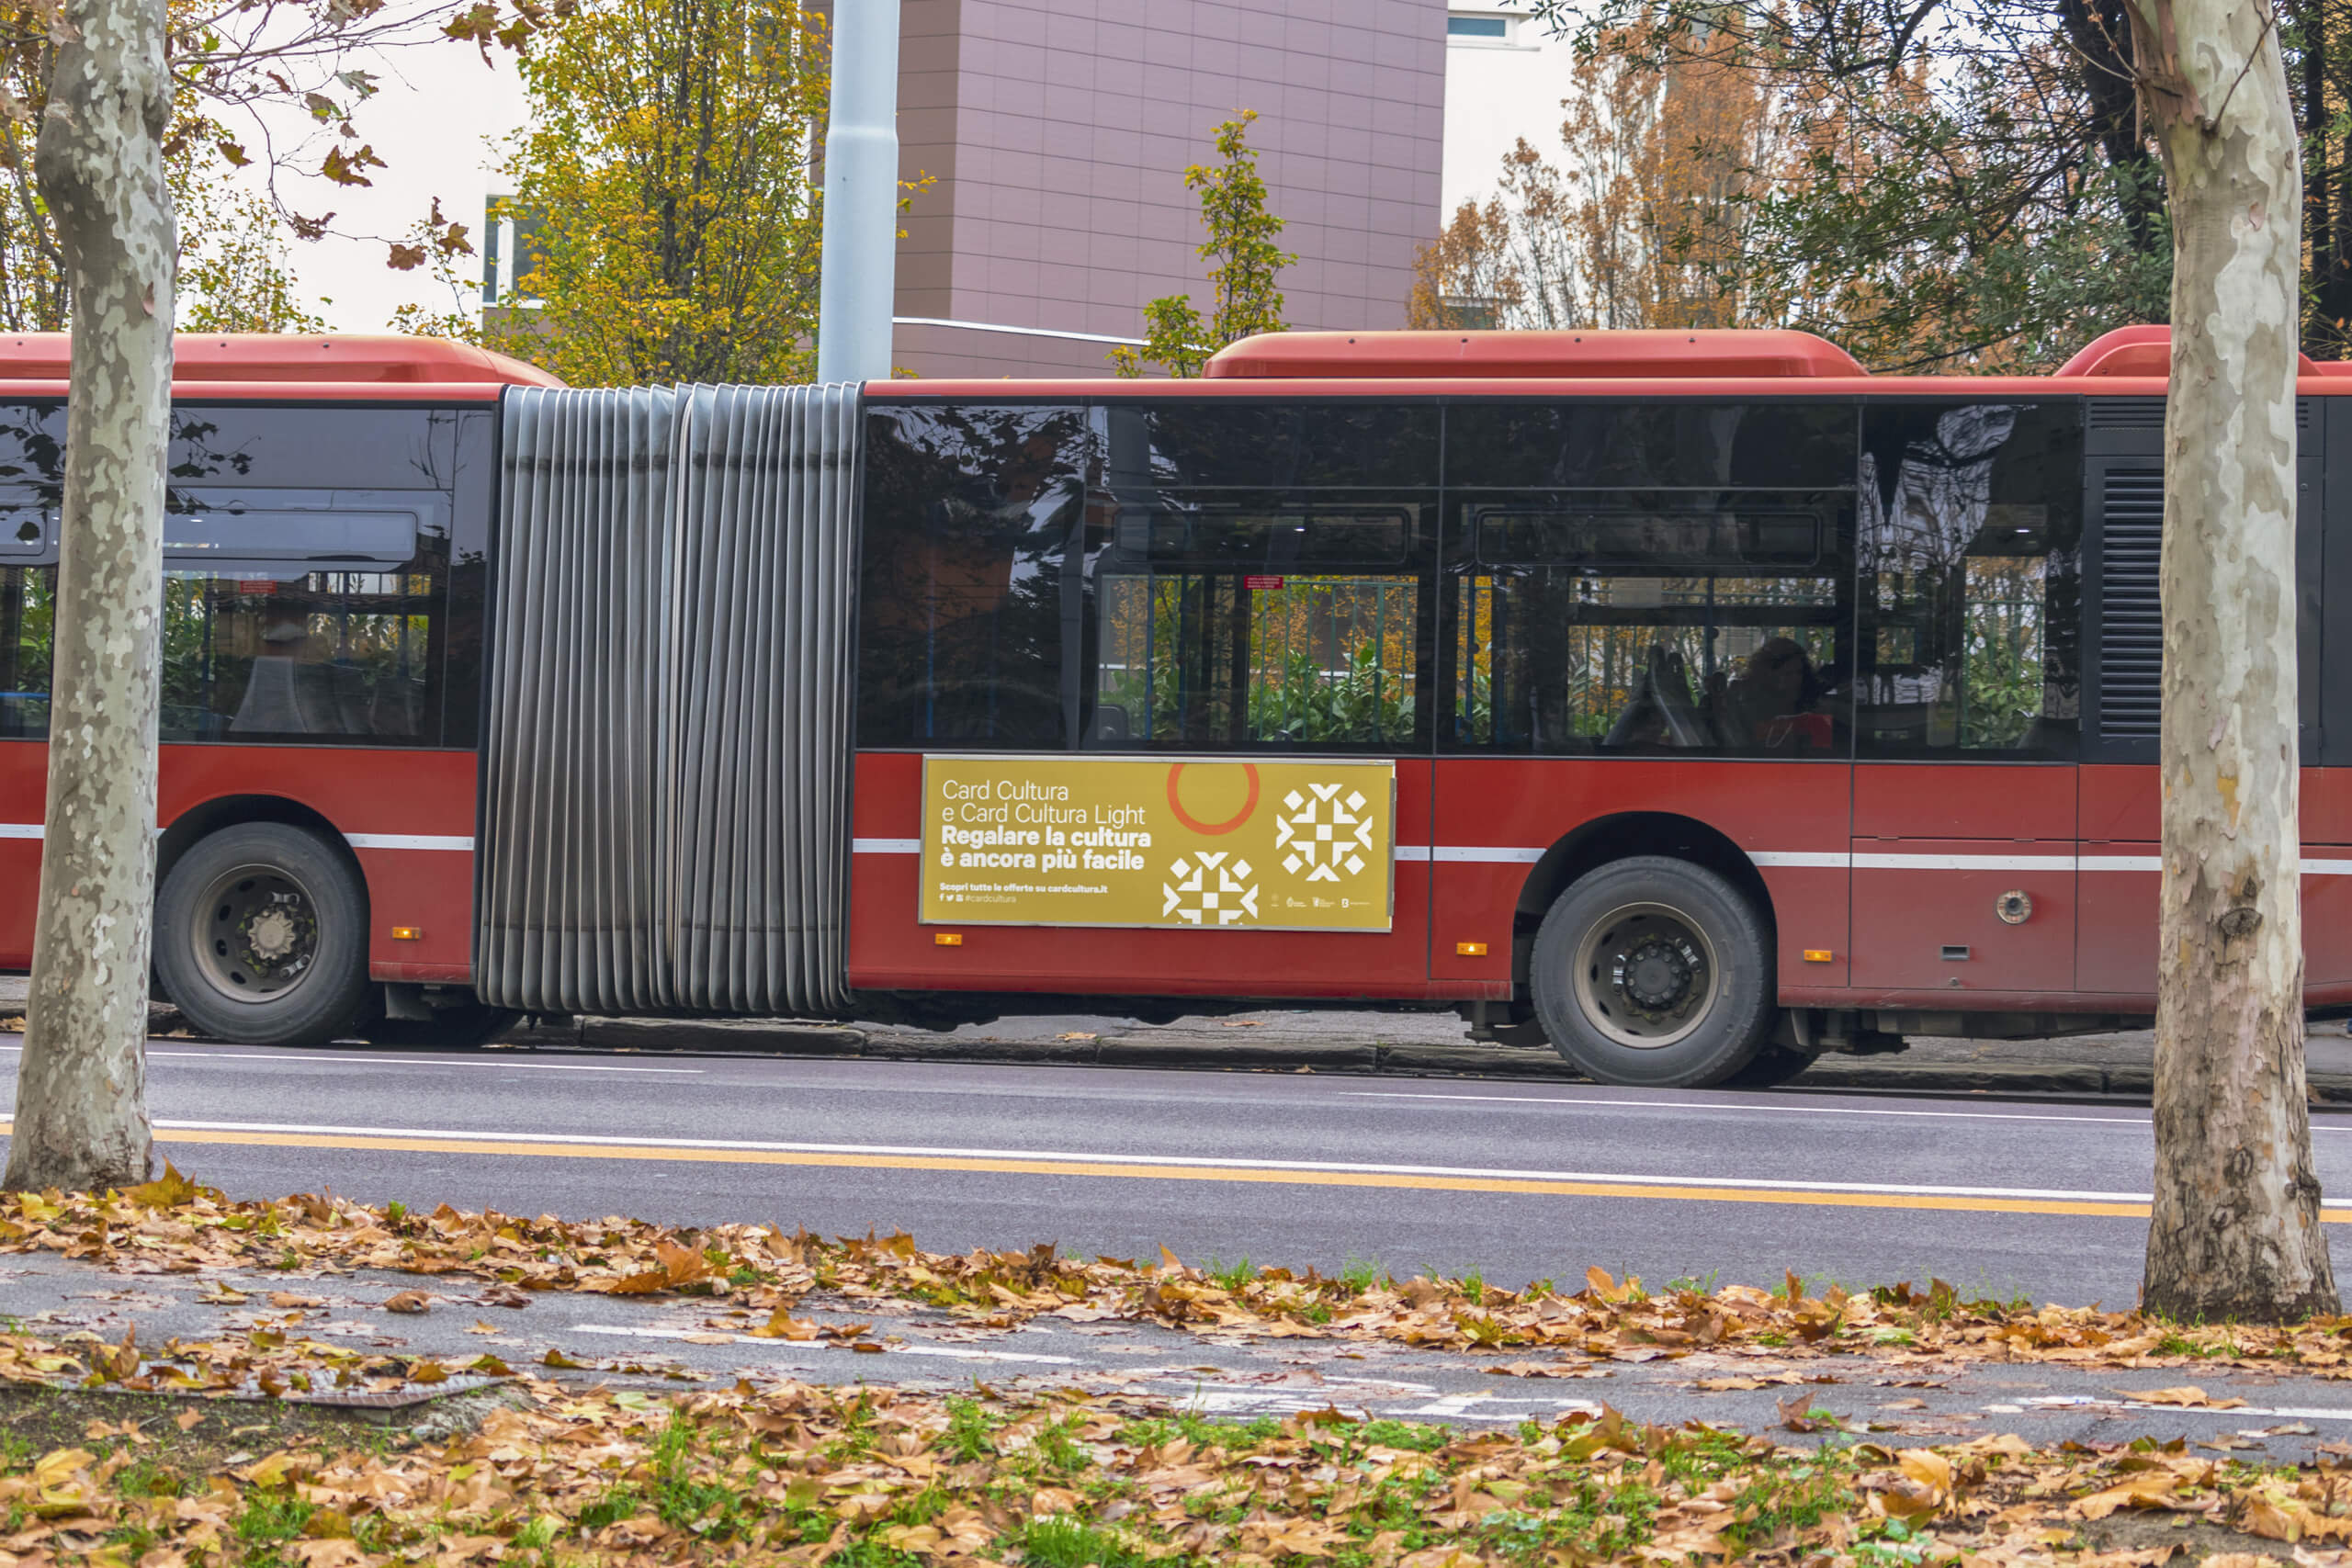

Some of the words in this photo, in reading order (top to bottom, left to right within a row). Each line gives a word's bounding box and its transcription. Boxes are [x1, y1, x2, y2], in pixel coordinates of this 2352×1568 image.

[943, 780, 989, 800] Card
[997, 780, 1069, 801] Cultura
[942, 807, 955, 822] e
[961, 802, 1008, 823] Card
[1015, 803, 1087, 824] Cultura
[1095, 805, 1146, 829] Light
[942, 825, 1040, 850] Regalare
[1046, 825, 1066, 846] la
[1070, 827, 1151, 848] cultura
[941, 847, 955, 867] è
[959, 852, 1036, 868] ancora
[1042, 848, 1077, 874] più
[1082, 849, 1145, 870] facile
[939, 883, 968, 893] Scopri
[970, 883, 992, 892] tutte
[993, 883, 1002, 892] le
[1003, 883, 1034, 893] offerte
[1035, 885, 1046, 893] su
[1047, 884, 1108, 894] cardcultura.it
[965, 894, 1017, 903] #cardcultura
